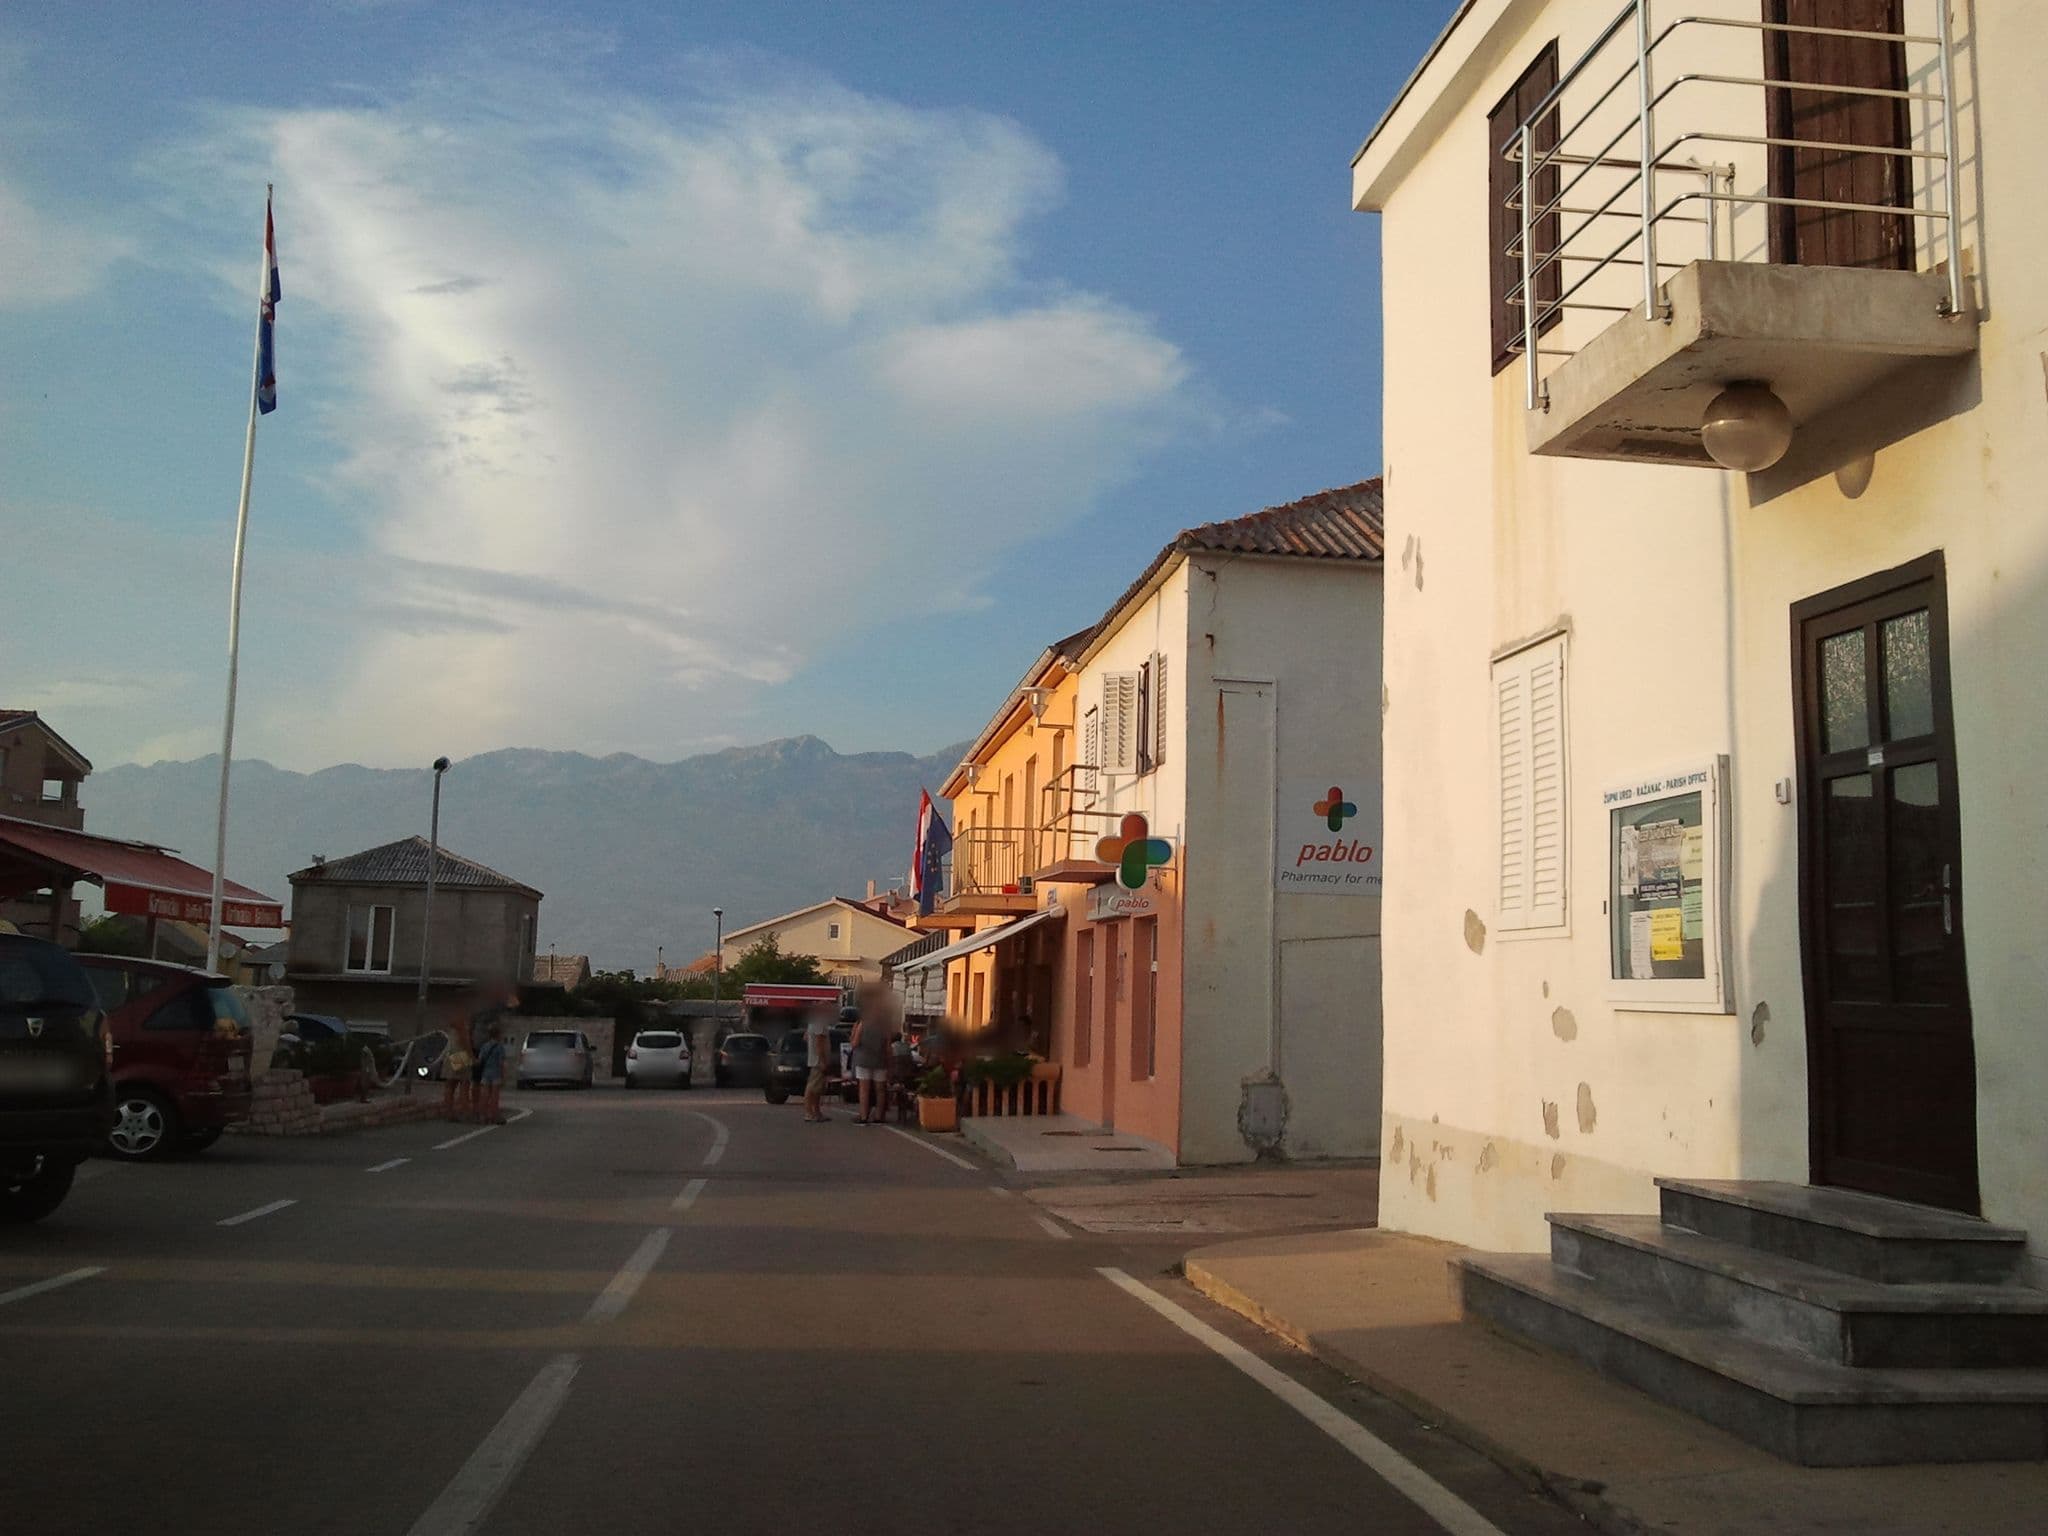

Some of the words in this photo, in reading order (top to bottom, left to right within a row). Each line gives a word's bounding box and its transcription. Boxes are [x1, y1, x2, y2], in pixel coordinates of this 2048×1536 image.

[1666, 776, 1686, 789] PARISH
[1688, 771, 1707, 785] OFFICE
[1296, 838, 1373, 867] pablo
[1281, 871, 1341, 884] Pharmacy
[1345, 873, 1363, 884] for
[1115, 897, 1149, 910] pablo
